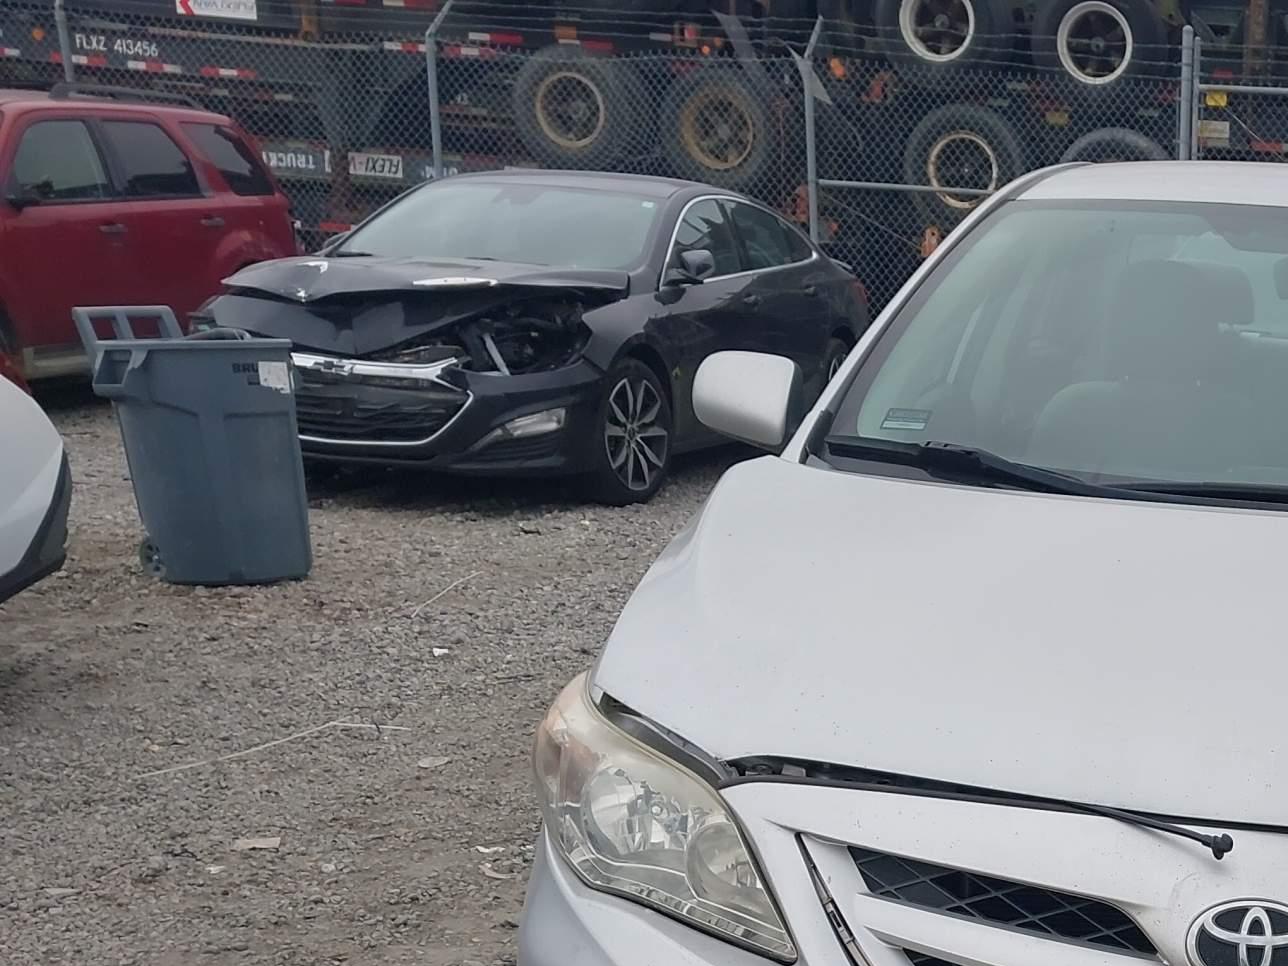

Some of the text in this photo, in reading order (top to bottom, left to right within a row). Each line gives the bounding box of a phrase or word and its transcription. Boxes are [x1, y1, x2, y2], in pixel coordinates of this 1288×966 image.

[75, 33, 159, 57] FLXZ 413456
[349, 155, 401, 175] FLEXI-V
[231, 362, 259, 374] BRU
